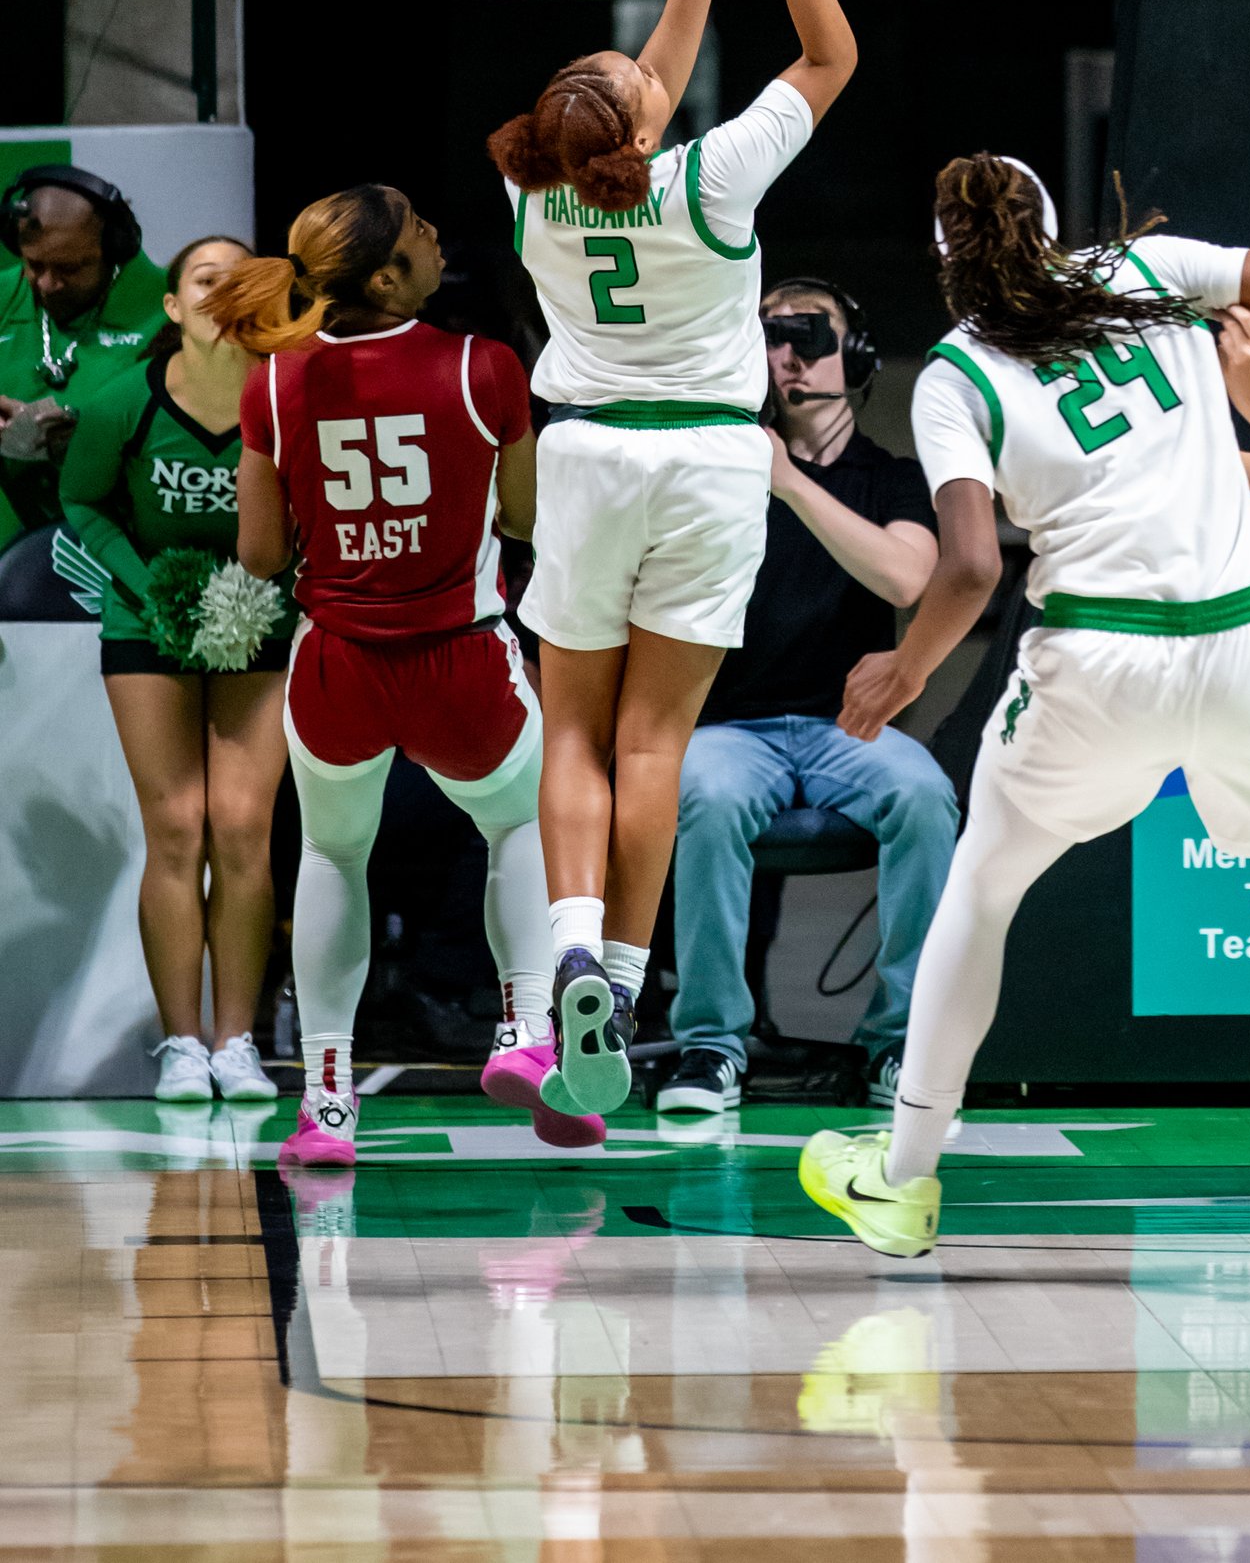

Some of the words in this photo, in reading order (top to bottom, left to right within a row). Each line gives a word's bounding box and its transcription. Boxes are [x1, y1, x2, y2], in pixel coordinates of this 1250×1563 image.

[584, 236, 646, 324] 2
[1032, 332, 1184, 455] 24
[150, 457, 239, 493] NOR
[317, 414, 432, 511] 55
[157, 488, 239, 515] TEX
[335, 515, 428, 561] EAST
